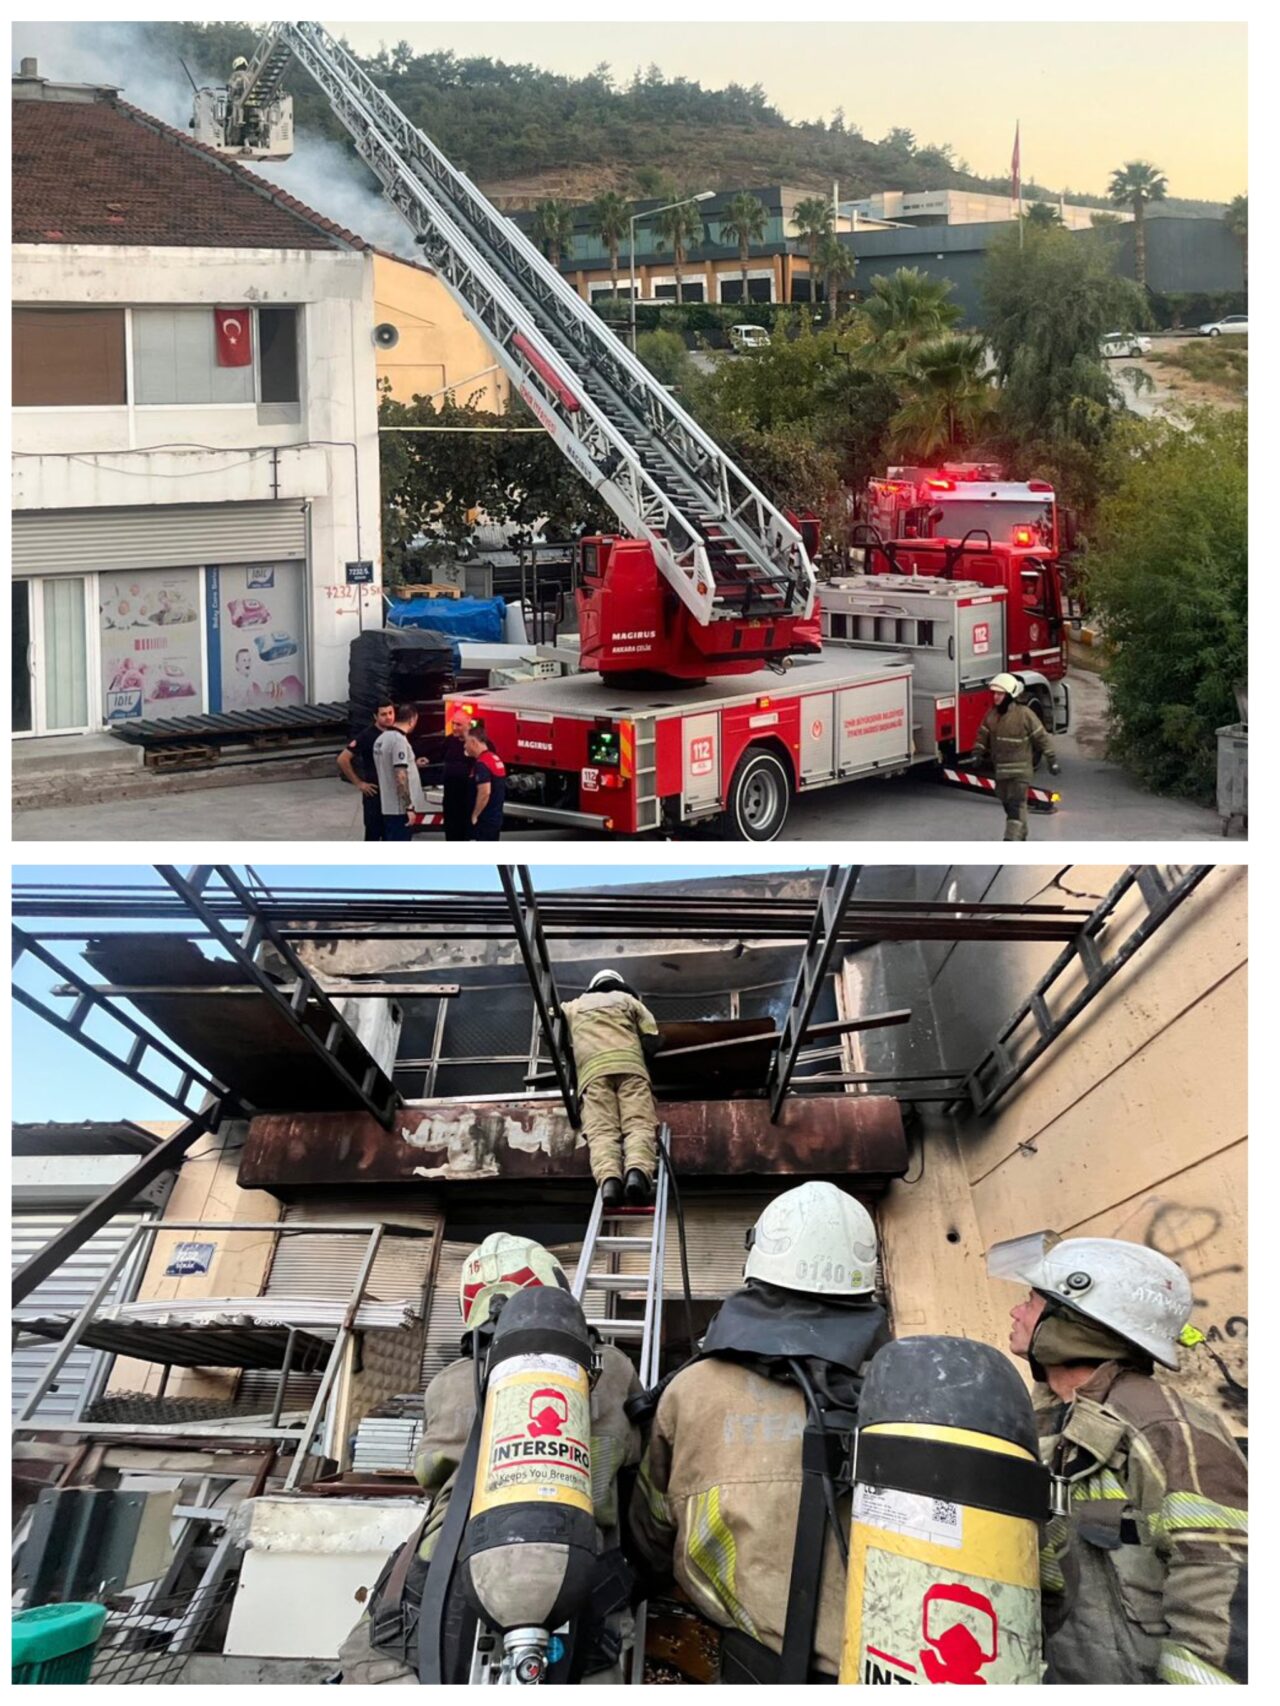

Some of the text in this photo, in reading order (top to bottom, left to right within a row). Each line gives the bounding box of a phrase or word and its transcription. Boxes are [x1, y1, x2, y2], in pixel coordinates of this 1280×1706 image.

[612, 630, 656, 640] MAGIRUS
[518, 739, 552, 751] MAGIRUS
[693, 741, 710, 761] 112
[584, 771, 597, 781] 112
[493, 1440, 591, 1468] INTERSPIRO
[529, 1468, 549, 1481] You
